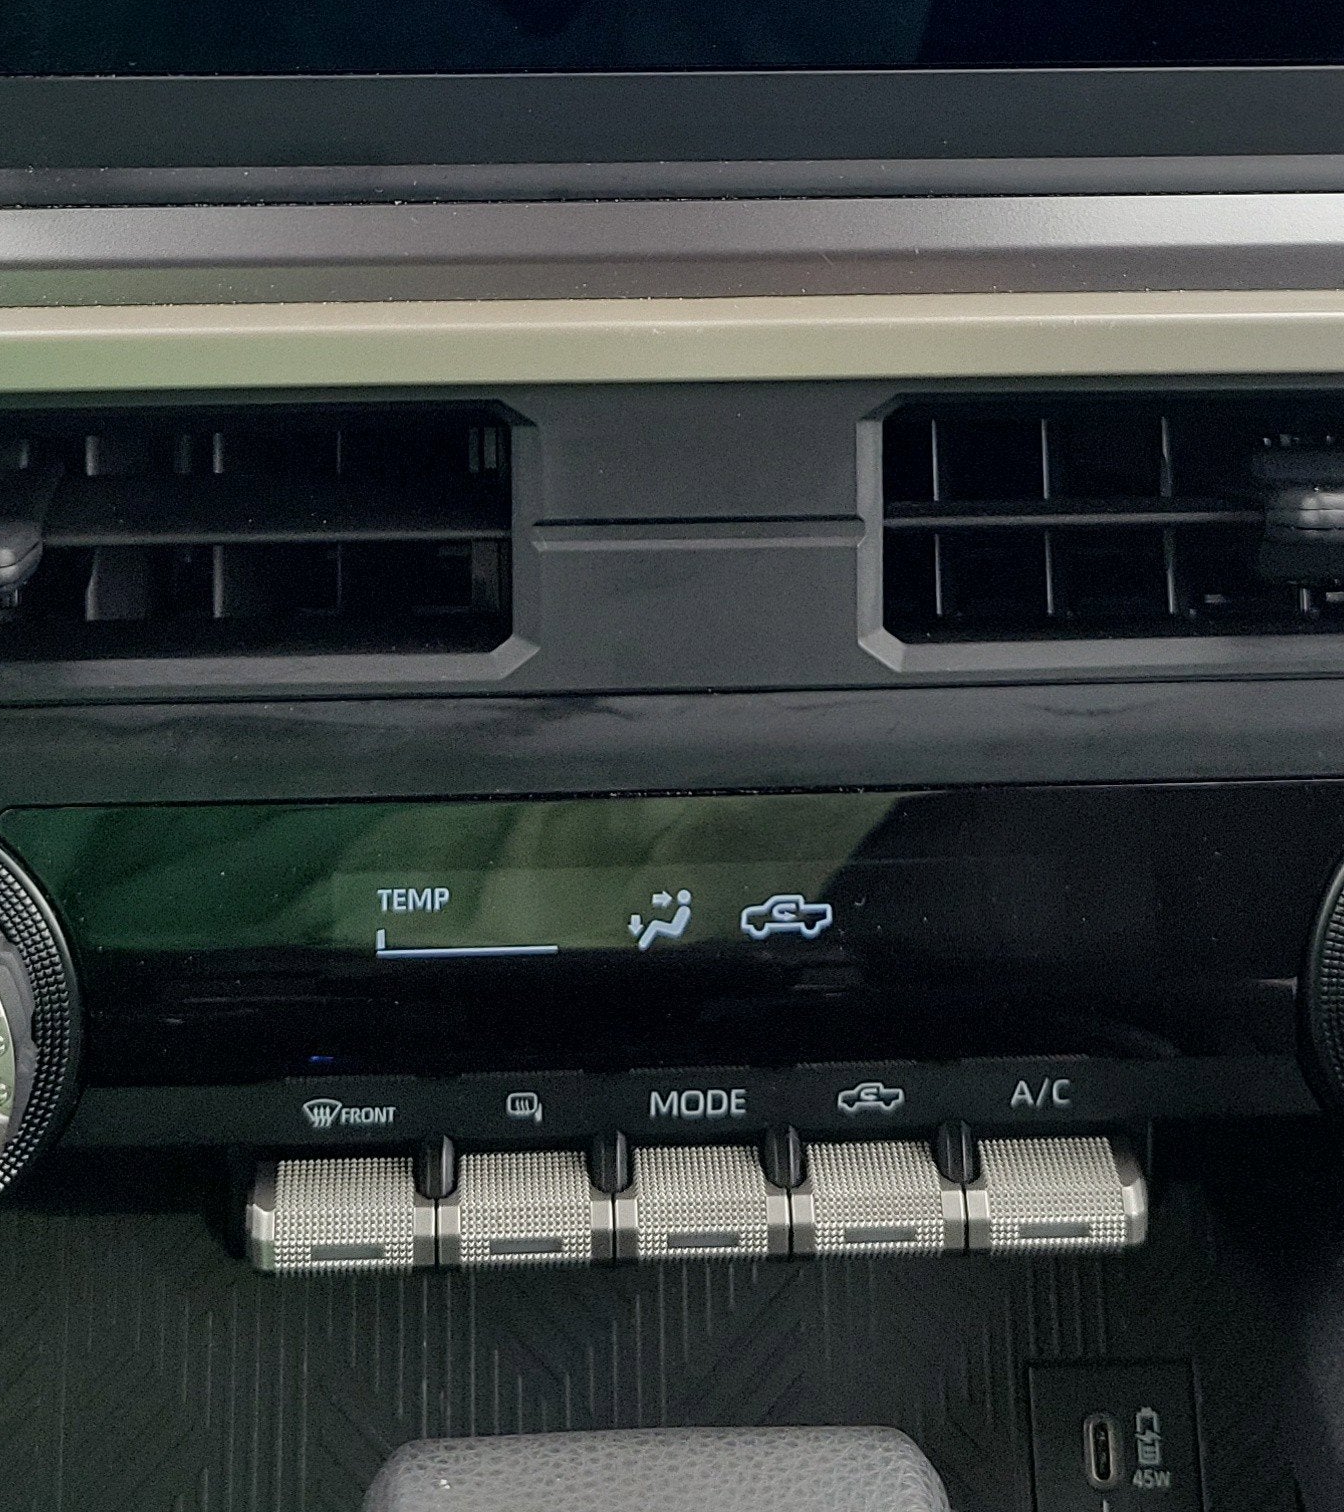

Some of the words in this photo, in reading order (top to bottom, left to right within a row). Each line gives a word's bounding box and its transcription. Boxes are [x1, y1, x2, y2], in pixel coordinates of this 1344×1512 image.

[378, 888, 450, 911] TEMP
[649, 1089, 748, 1119] MODE
[1011, 1079, 1071, 1108] A/C
[341, 1106, 396, 1124] FRONT
[1132, 1468, 1171, 1488] 45W
